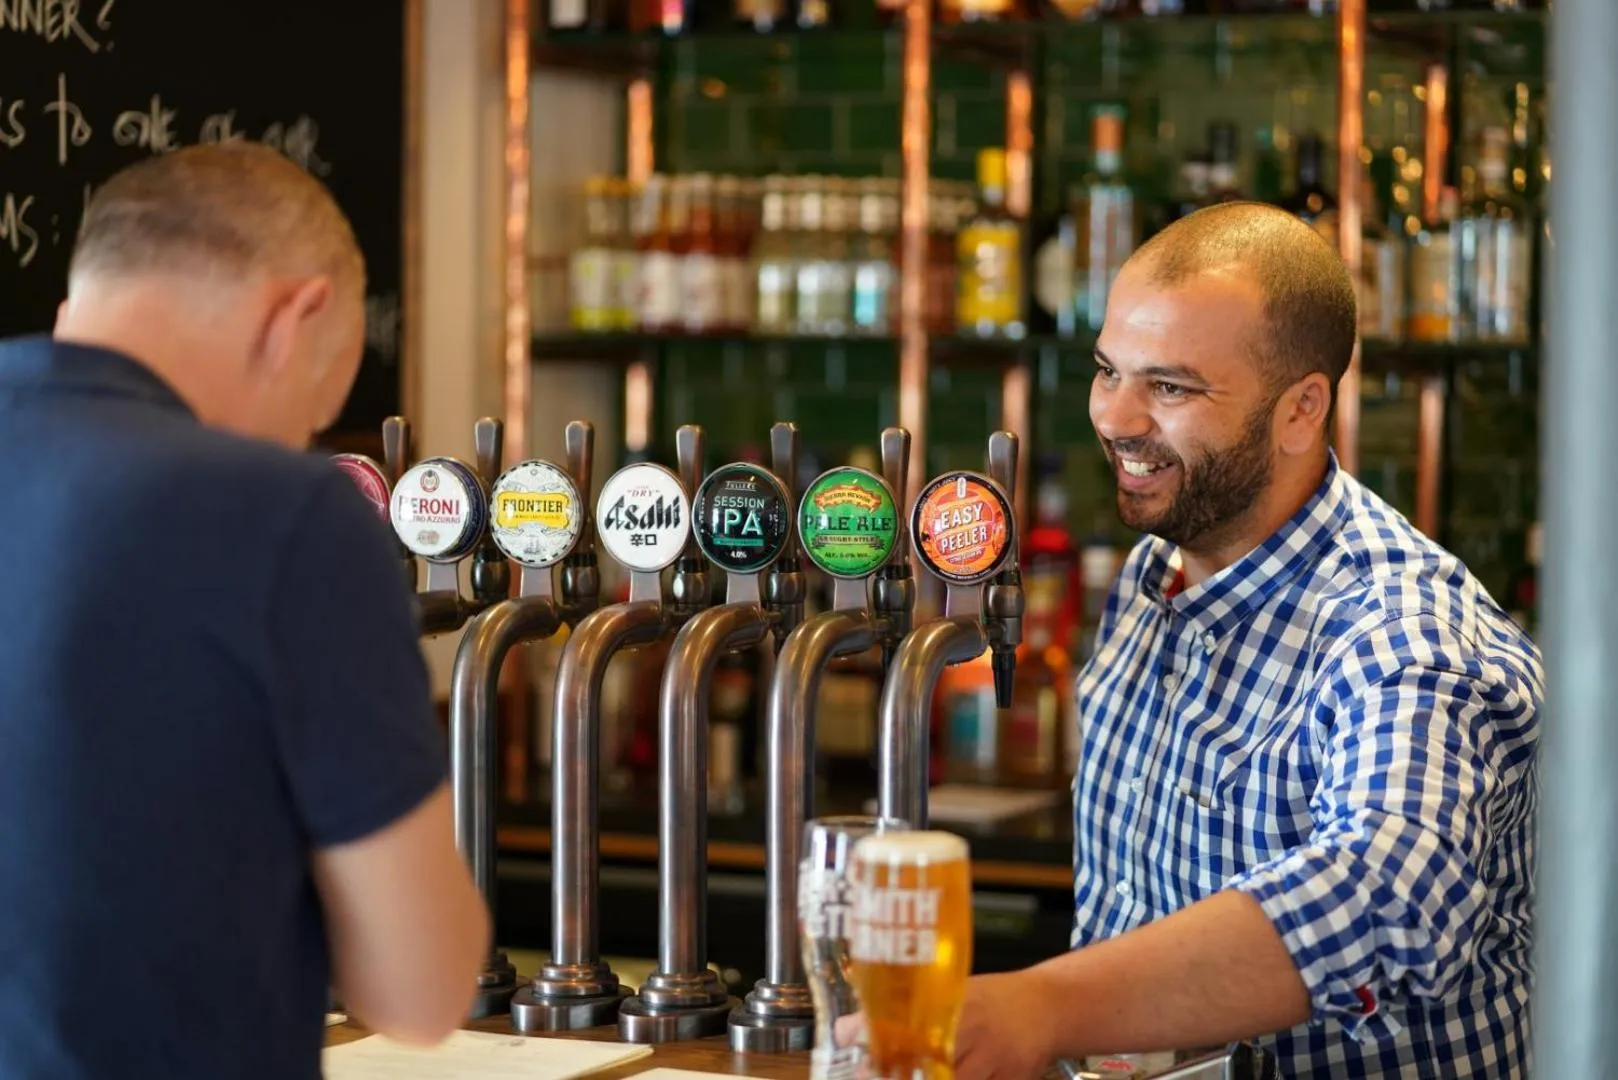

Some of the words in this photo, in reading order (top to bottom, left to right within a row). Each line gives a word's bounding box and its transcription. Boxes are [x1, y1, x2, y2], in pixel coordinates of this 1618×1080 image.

[502, 498, 563, 513] FRONTIER
[604, 494, 680, 530] Asahi
[713, 495, 765, 508] SESSION
[712, 507, 764, 535] IPA
[804, 514, 850, 531] PALE
[856, 515, 892, 531] ALE
[940, 501, 984, 530] EASY
[630, 533, 658, 546] 辛口
[941, 526, 987, 554] PEELER
